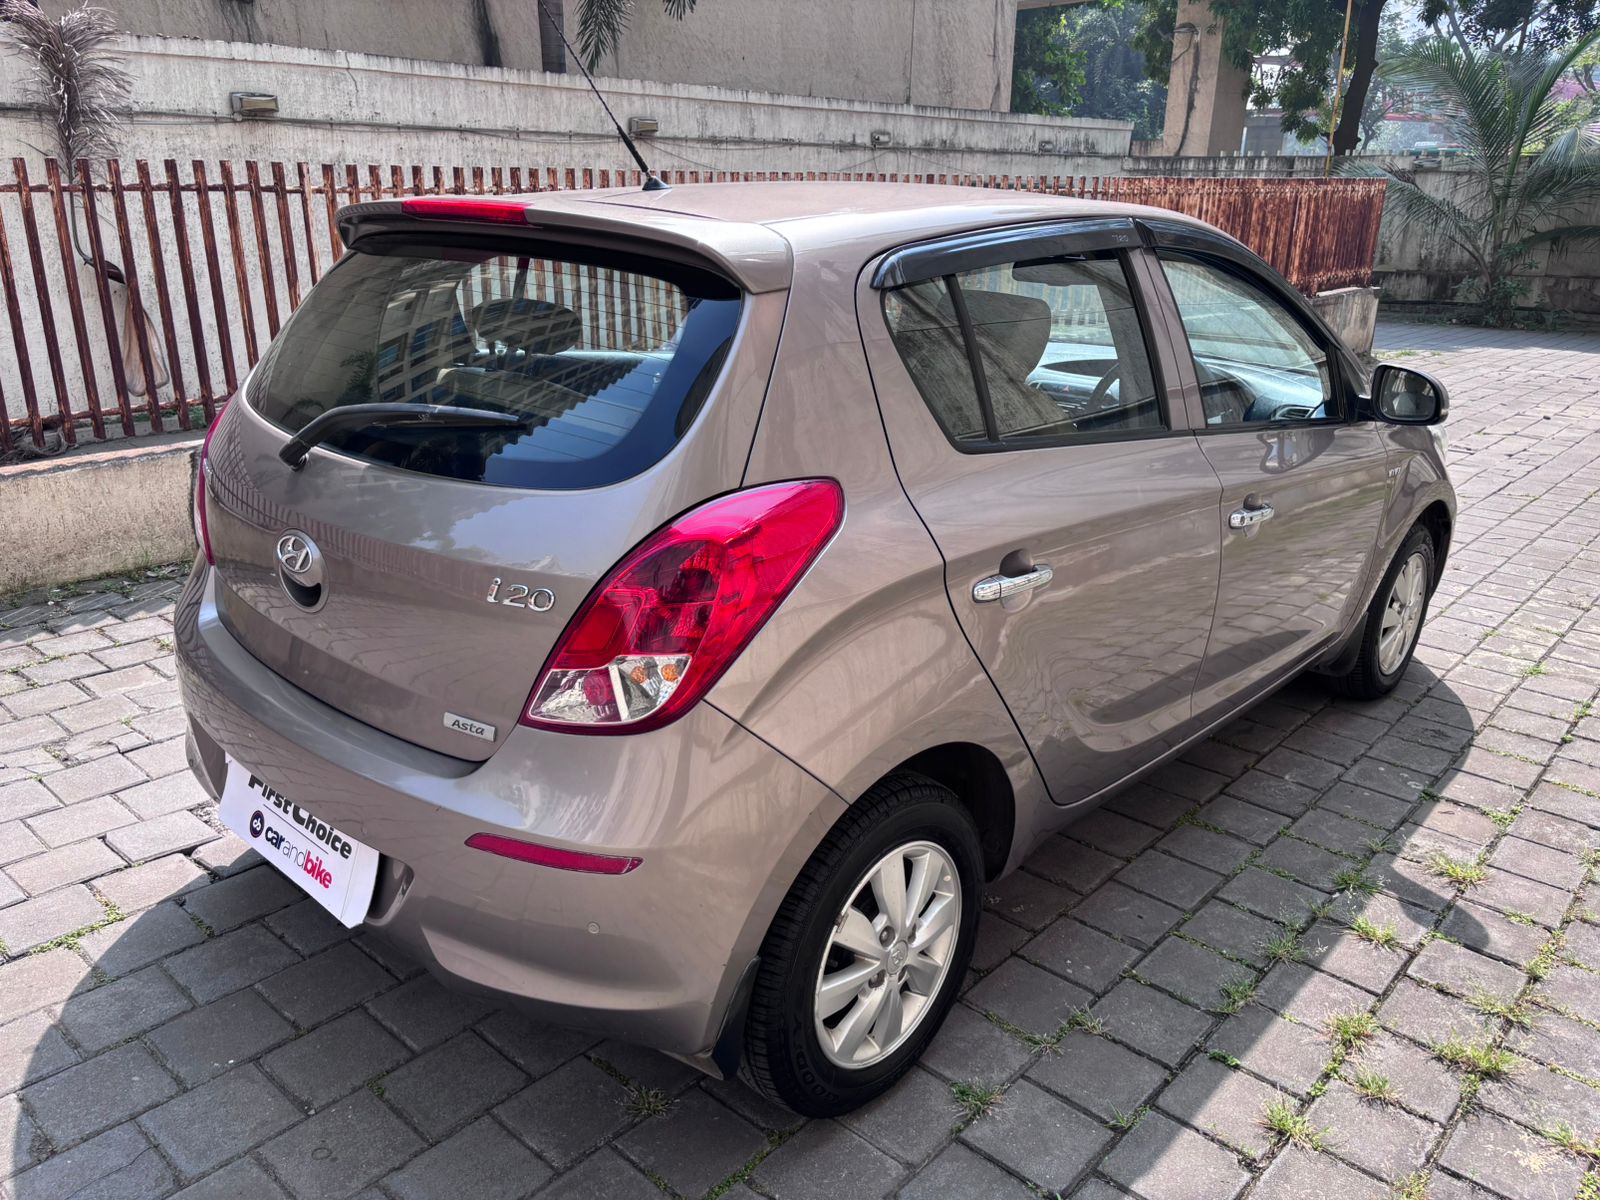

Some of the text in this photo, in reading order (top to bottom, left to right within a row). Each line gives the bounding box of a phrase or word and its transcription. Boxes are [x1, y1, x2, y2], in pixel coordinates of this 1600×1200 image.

[486, 577, 555, 612] i20
[451, 718, 486, 736] Asta
[264, 825, 332, 888] carandbike
